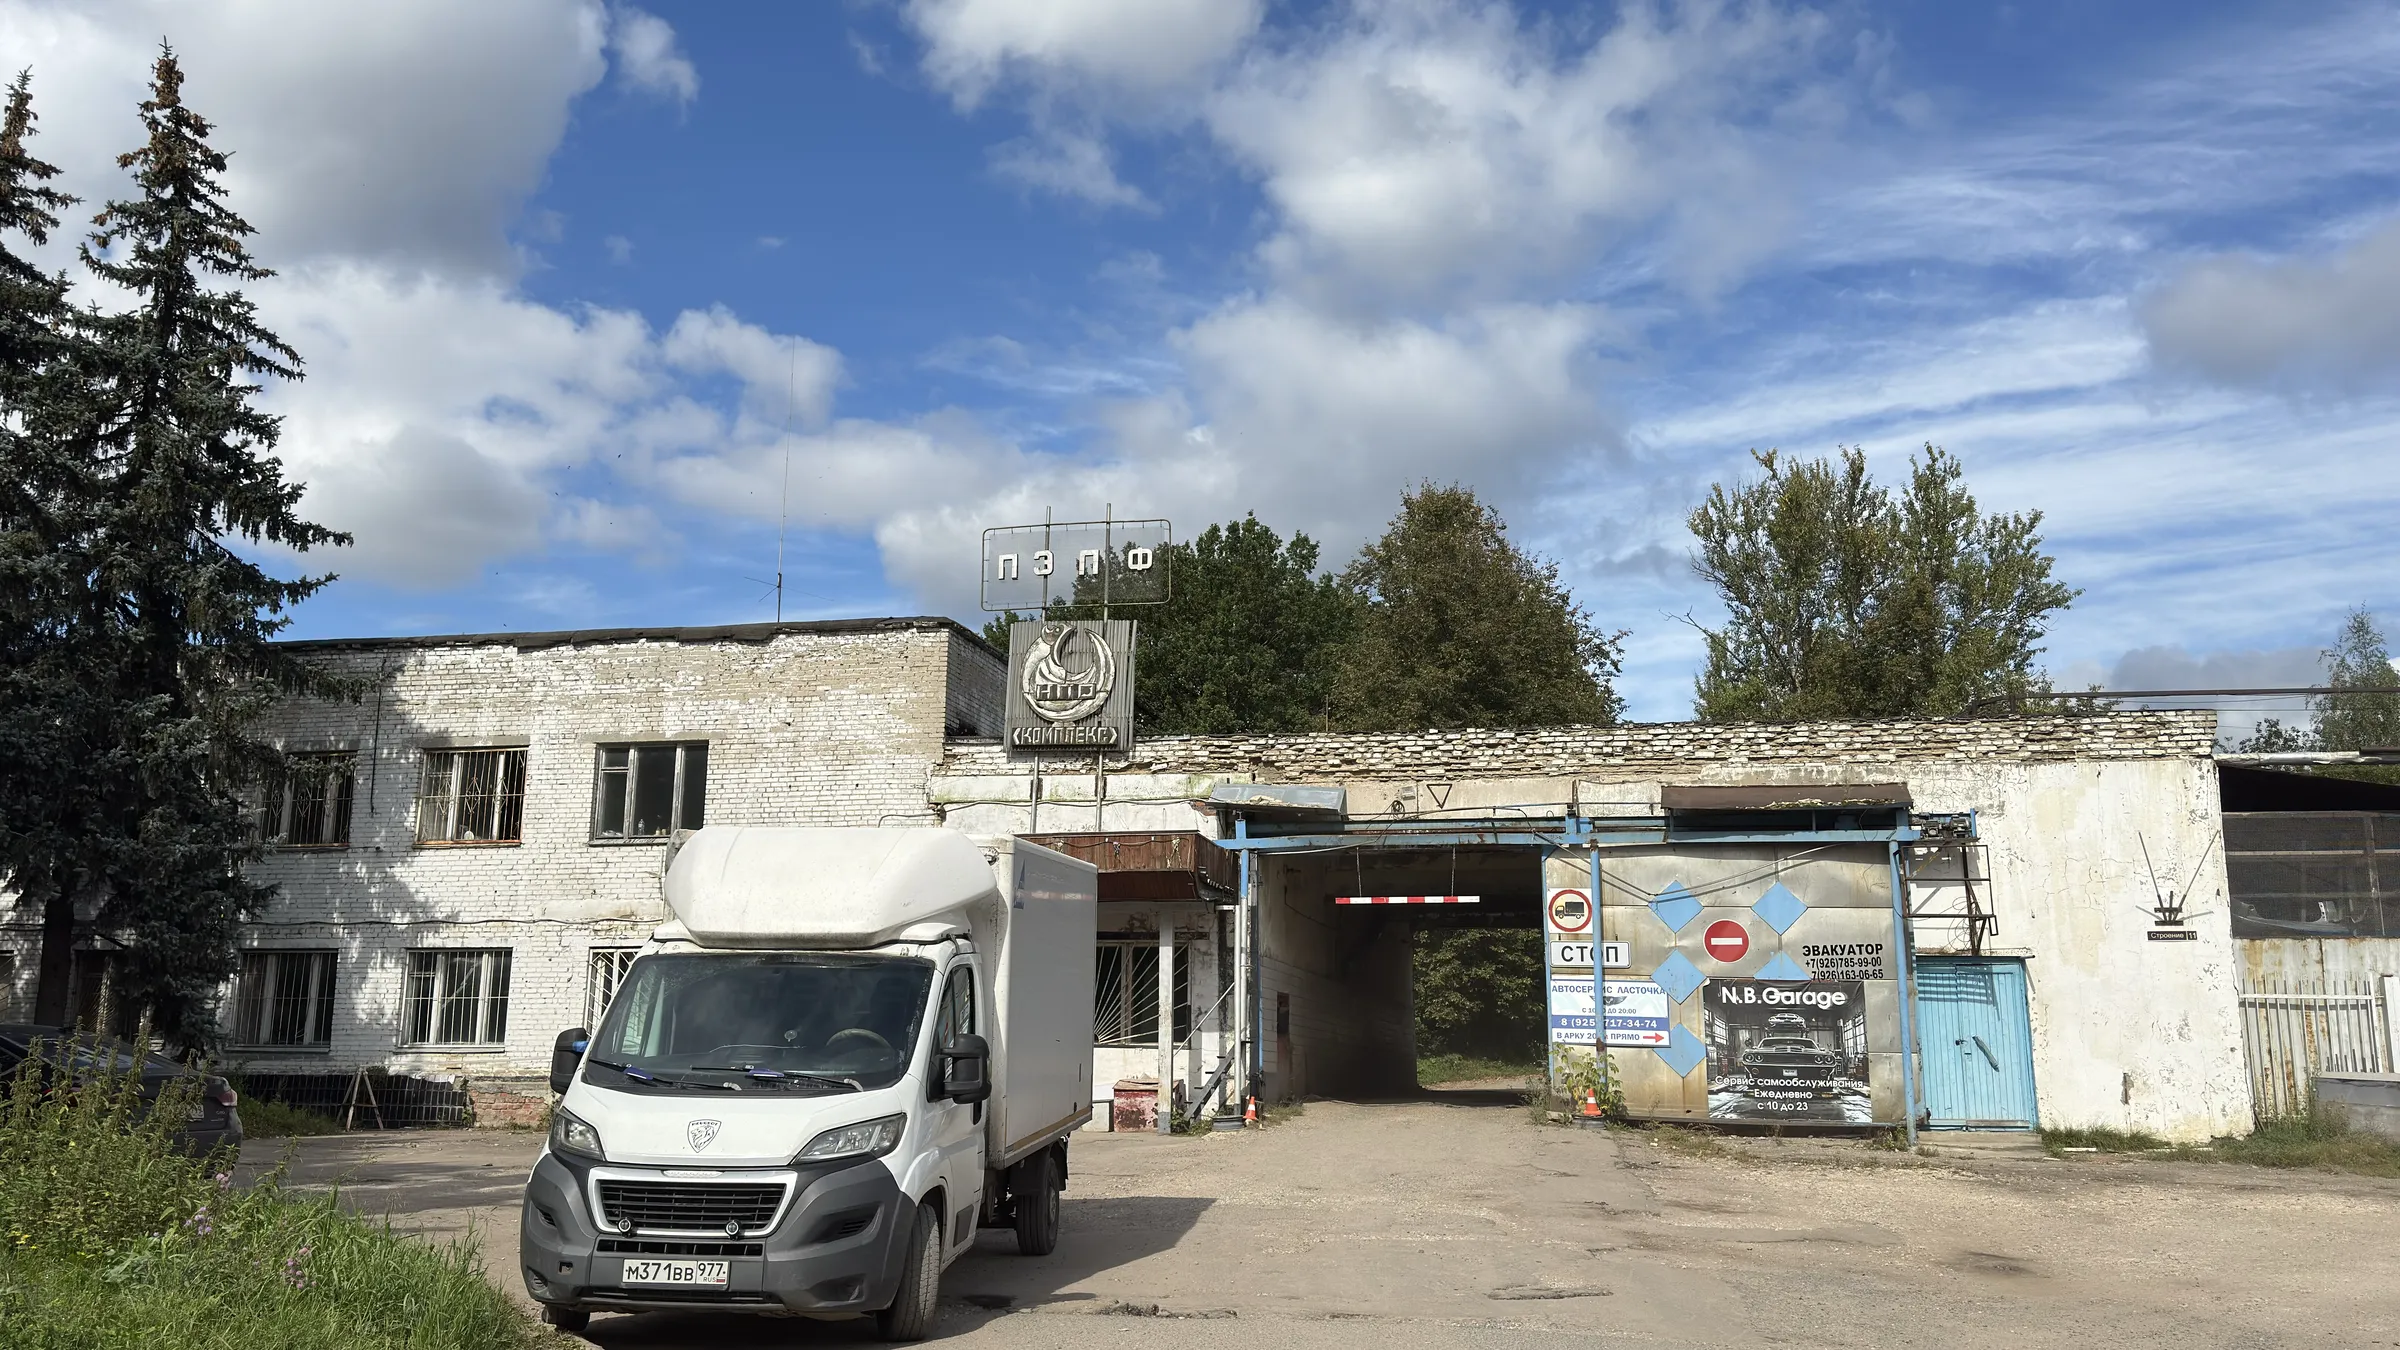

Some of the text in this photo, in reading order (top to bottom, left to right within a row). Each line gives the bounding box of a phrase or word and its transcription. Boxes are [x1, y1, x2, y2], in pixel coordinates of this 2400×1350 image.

[1802, 943, 1883, 957] ЭВАКУАТОР
[1805, 956, 1882, 970] +7(926)785-99-00
[1617, 986, 1666, 995] ЛАСТОЧКА
[1561, 1018, 1568, 1026] 8
[1715, 1075, 1864, 1090] Сервис самообслуживания
[1754, 1089, 1813, 1100] Ежедневно
[1766, 1101, 1778, 1110] 10
[1780, 1102, 1795, 1111] до
[1796, 1101, 1809, 1111] 23
[698, 1262, 724, 1277] 977
